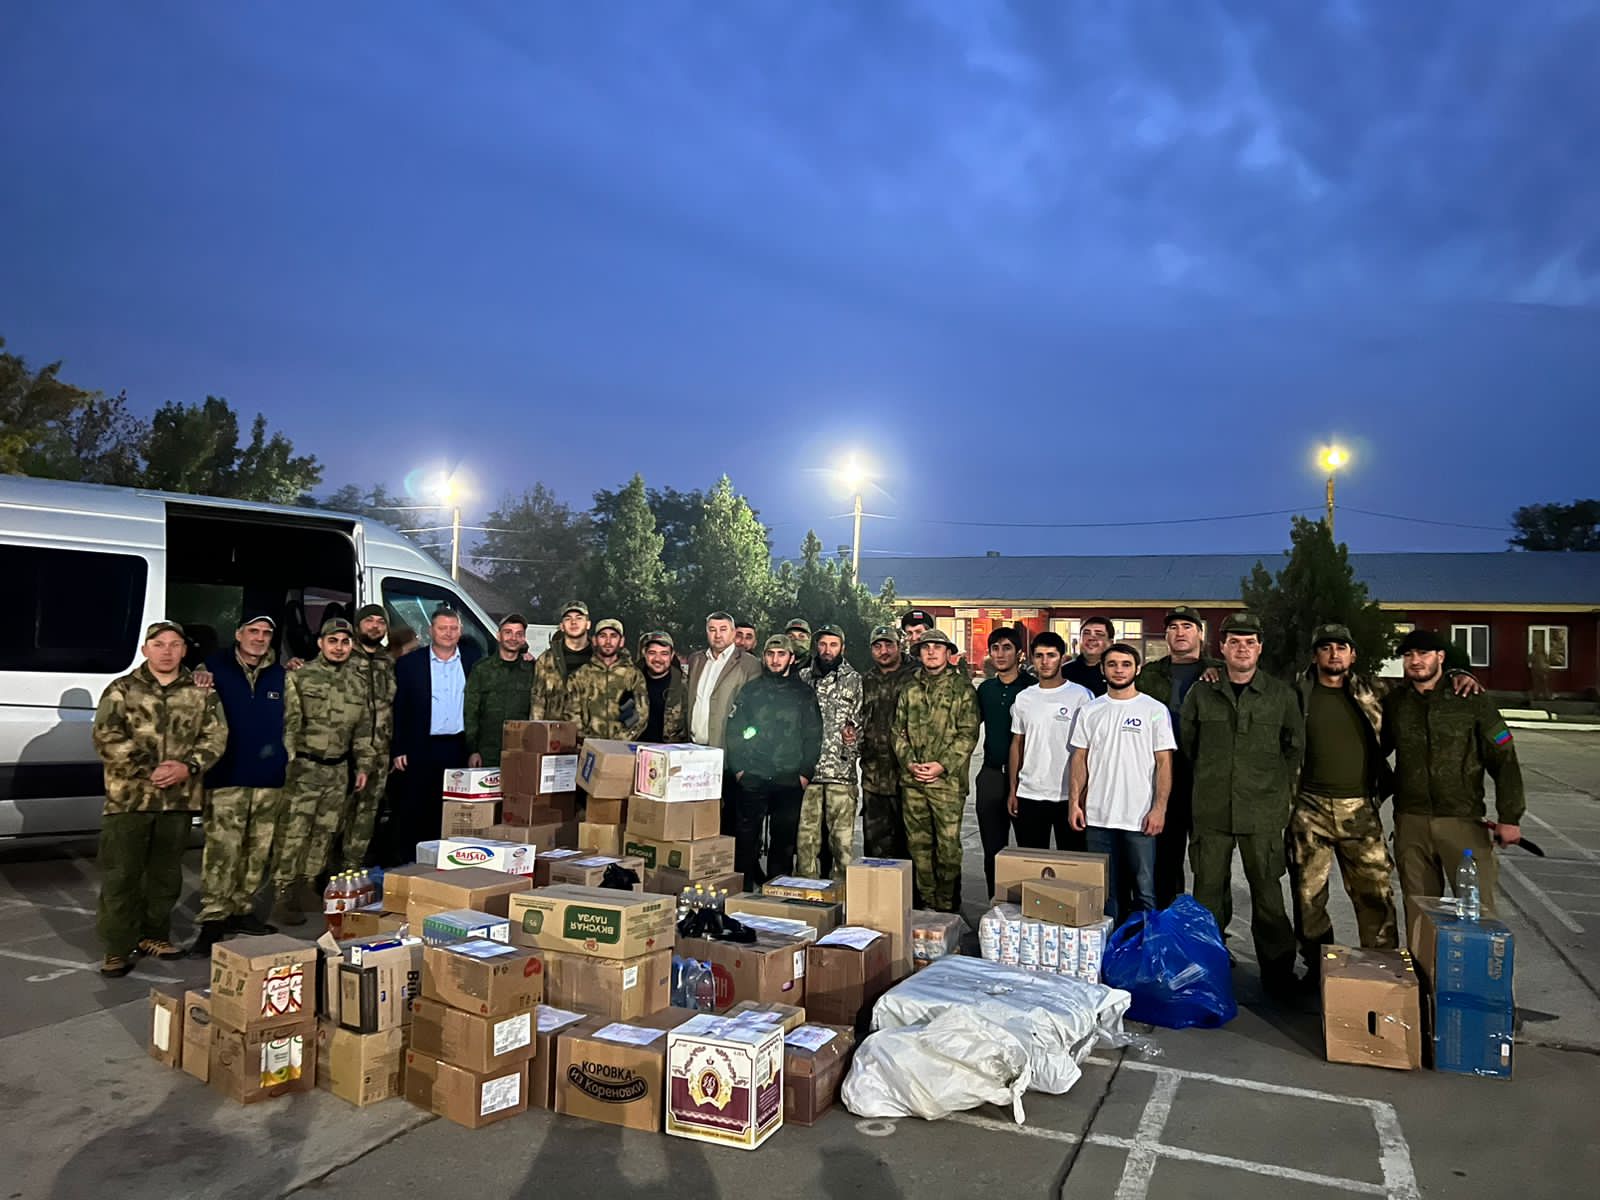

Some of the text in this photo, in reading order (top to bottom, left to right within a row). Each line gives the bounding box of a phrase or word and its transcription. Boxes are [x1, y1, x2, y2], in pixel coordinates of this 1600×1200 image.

[577, 912, 608, 924] ПАУЗА
[570, 920, 614, 935] ВКУСНАЯ
[582, 1060, 633, 1081] КОРОВКА
